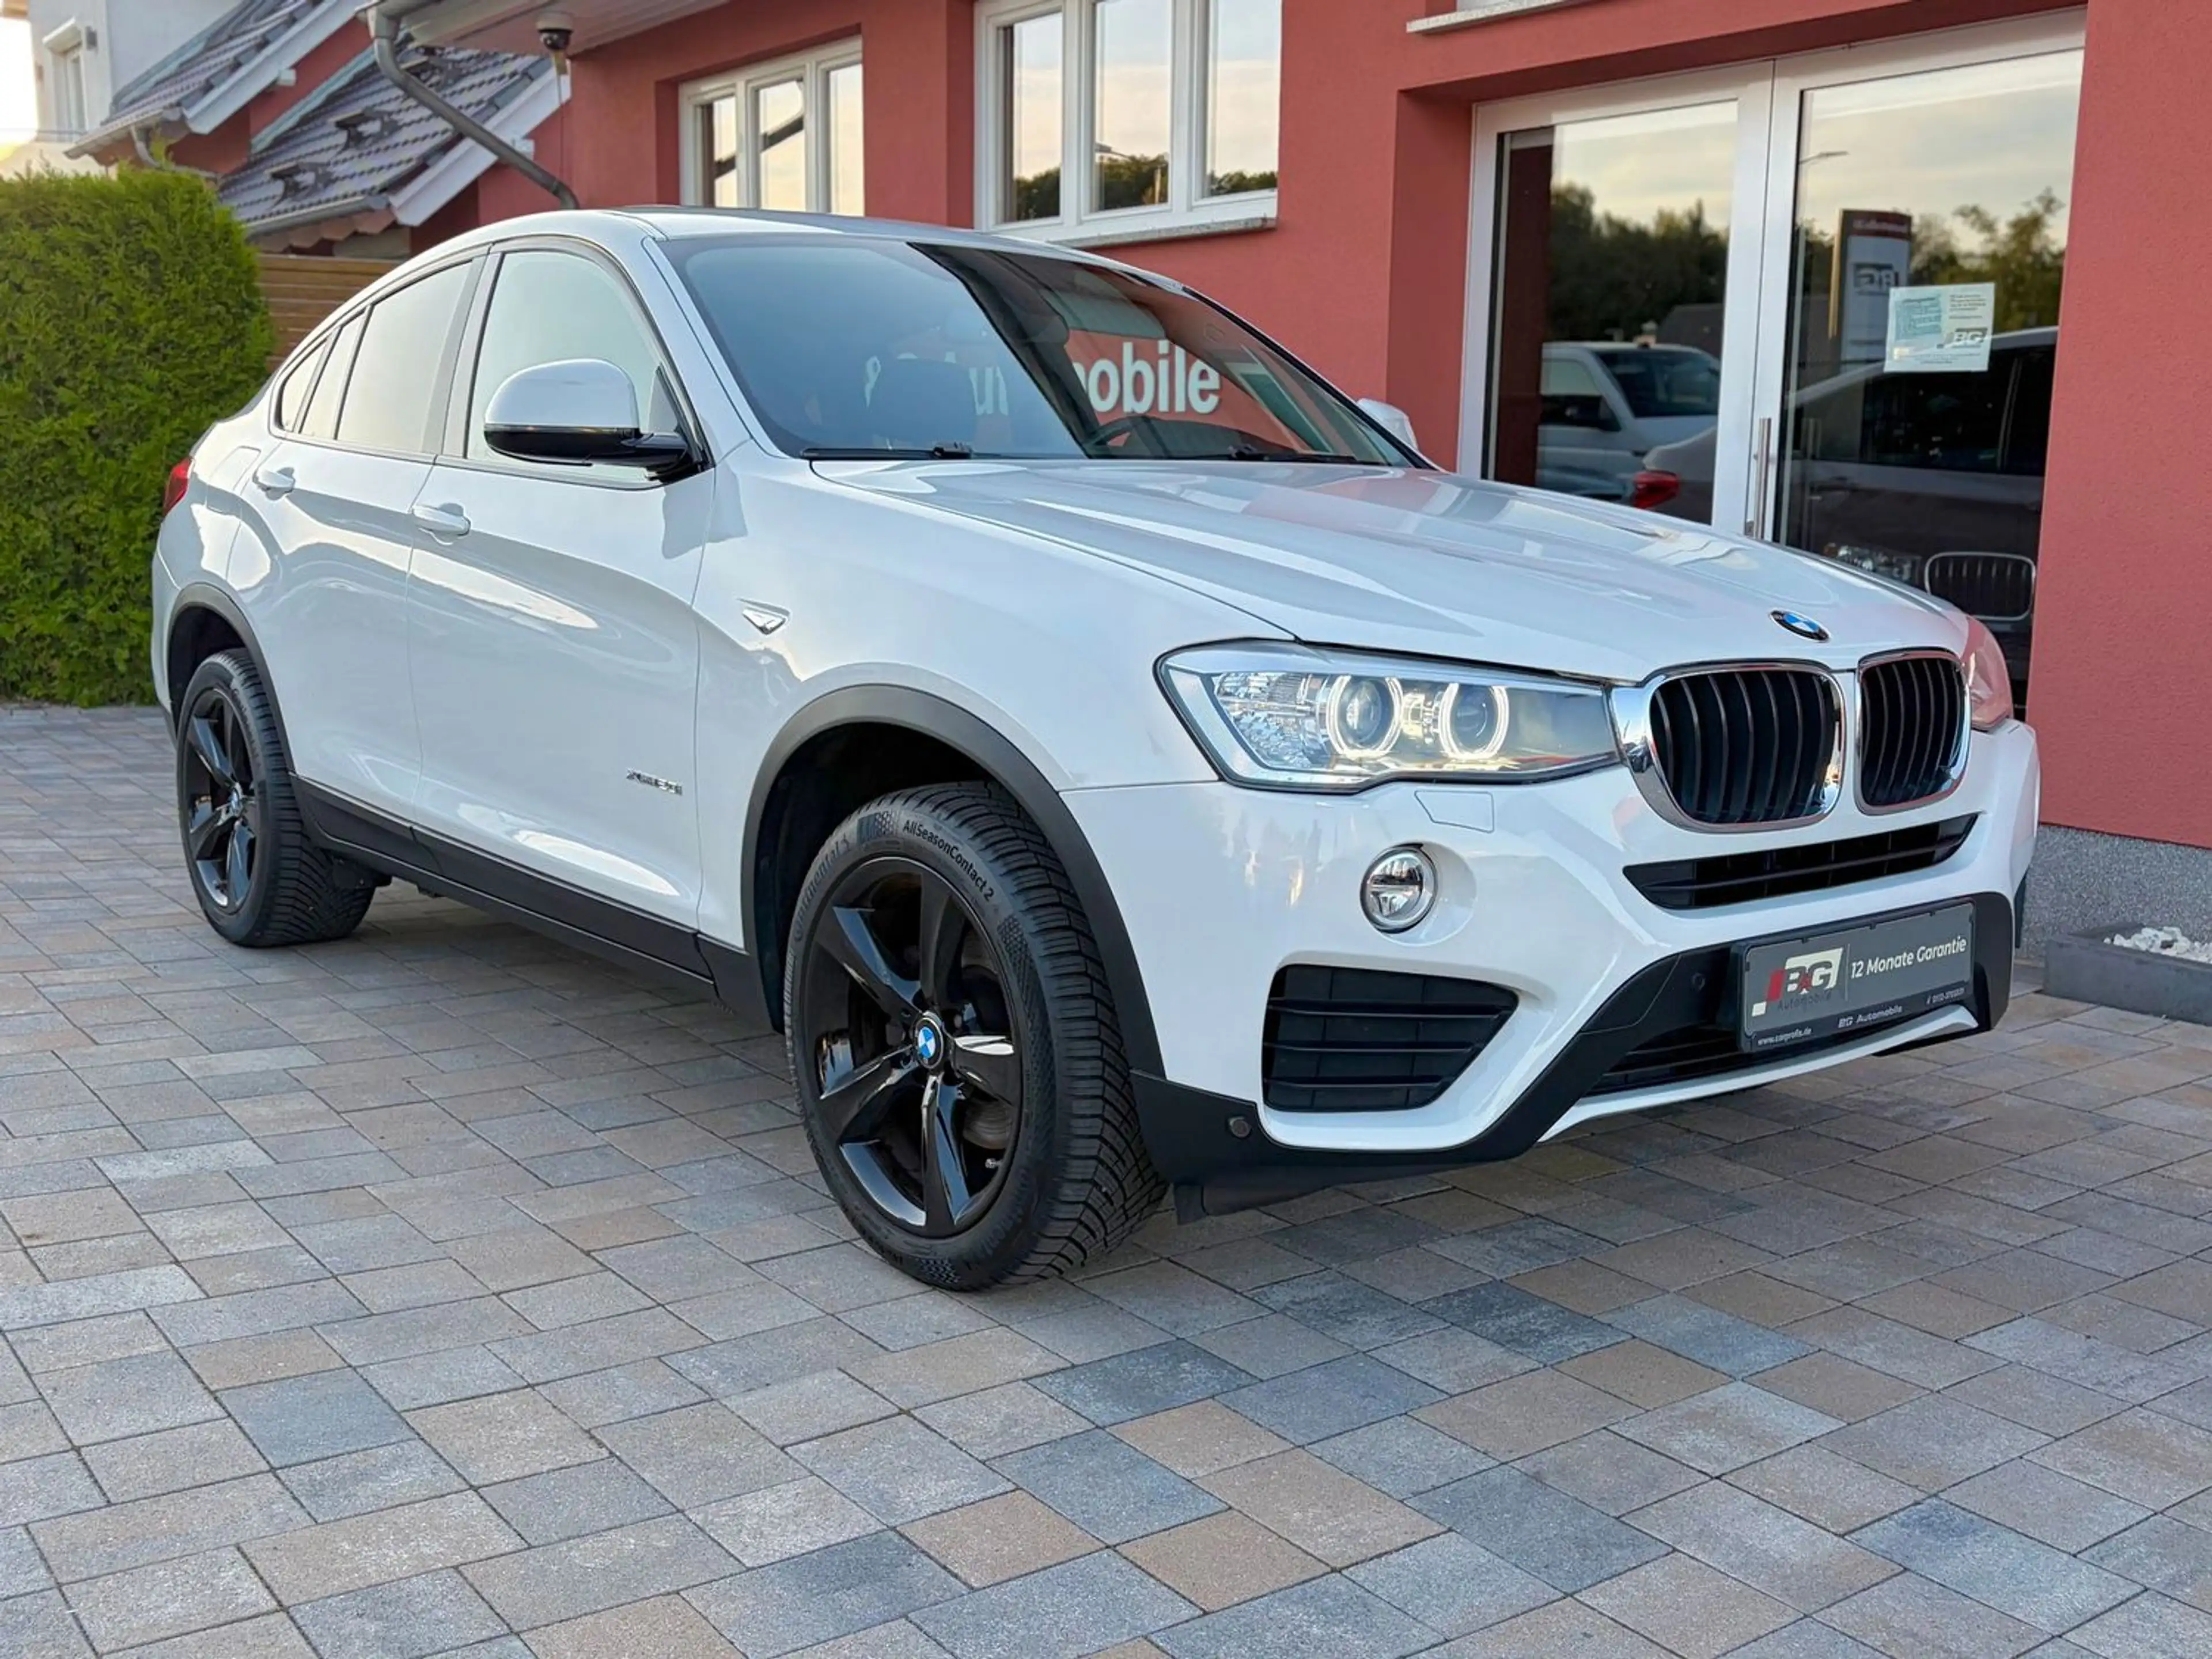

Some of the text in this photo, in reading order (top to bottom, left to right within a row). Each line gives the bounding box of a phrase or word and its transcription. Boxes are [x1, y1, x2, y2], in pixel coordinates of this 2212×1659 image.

[903, 819, 995, 902] AllSeasonContact 2
[1851, 935, 1968, 979] 12 Monate Garantie
[1856, 1005, 1903, 1024] Automobile
